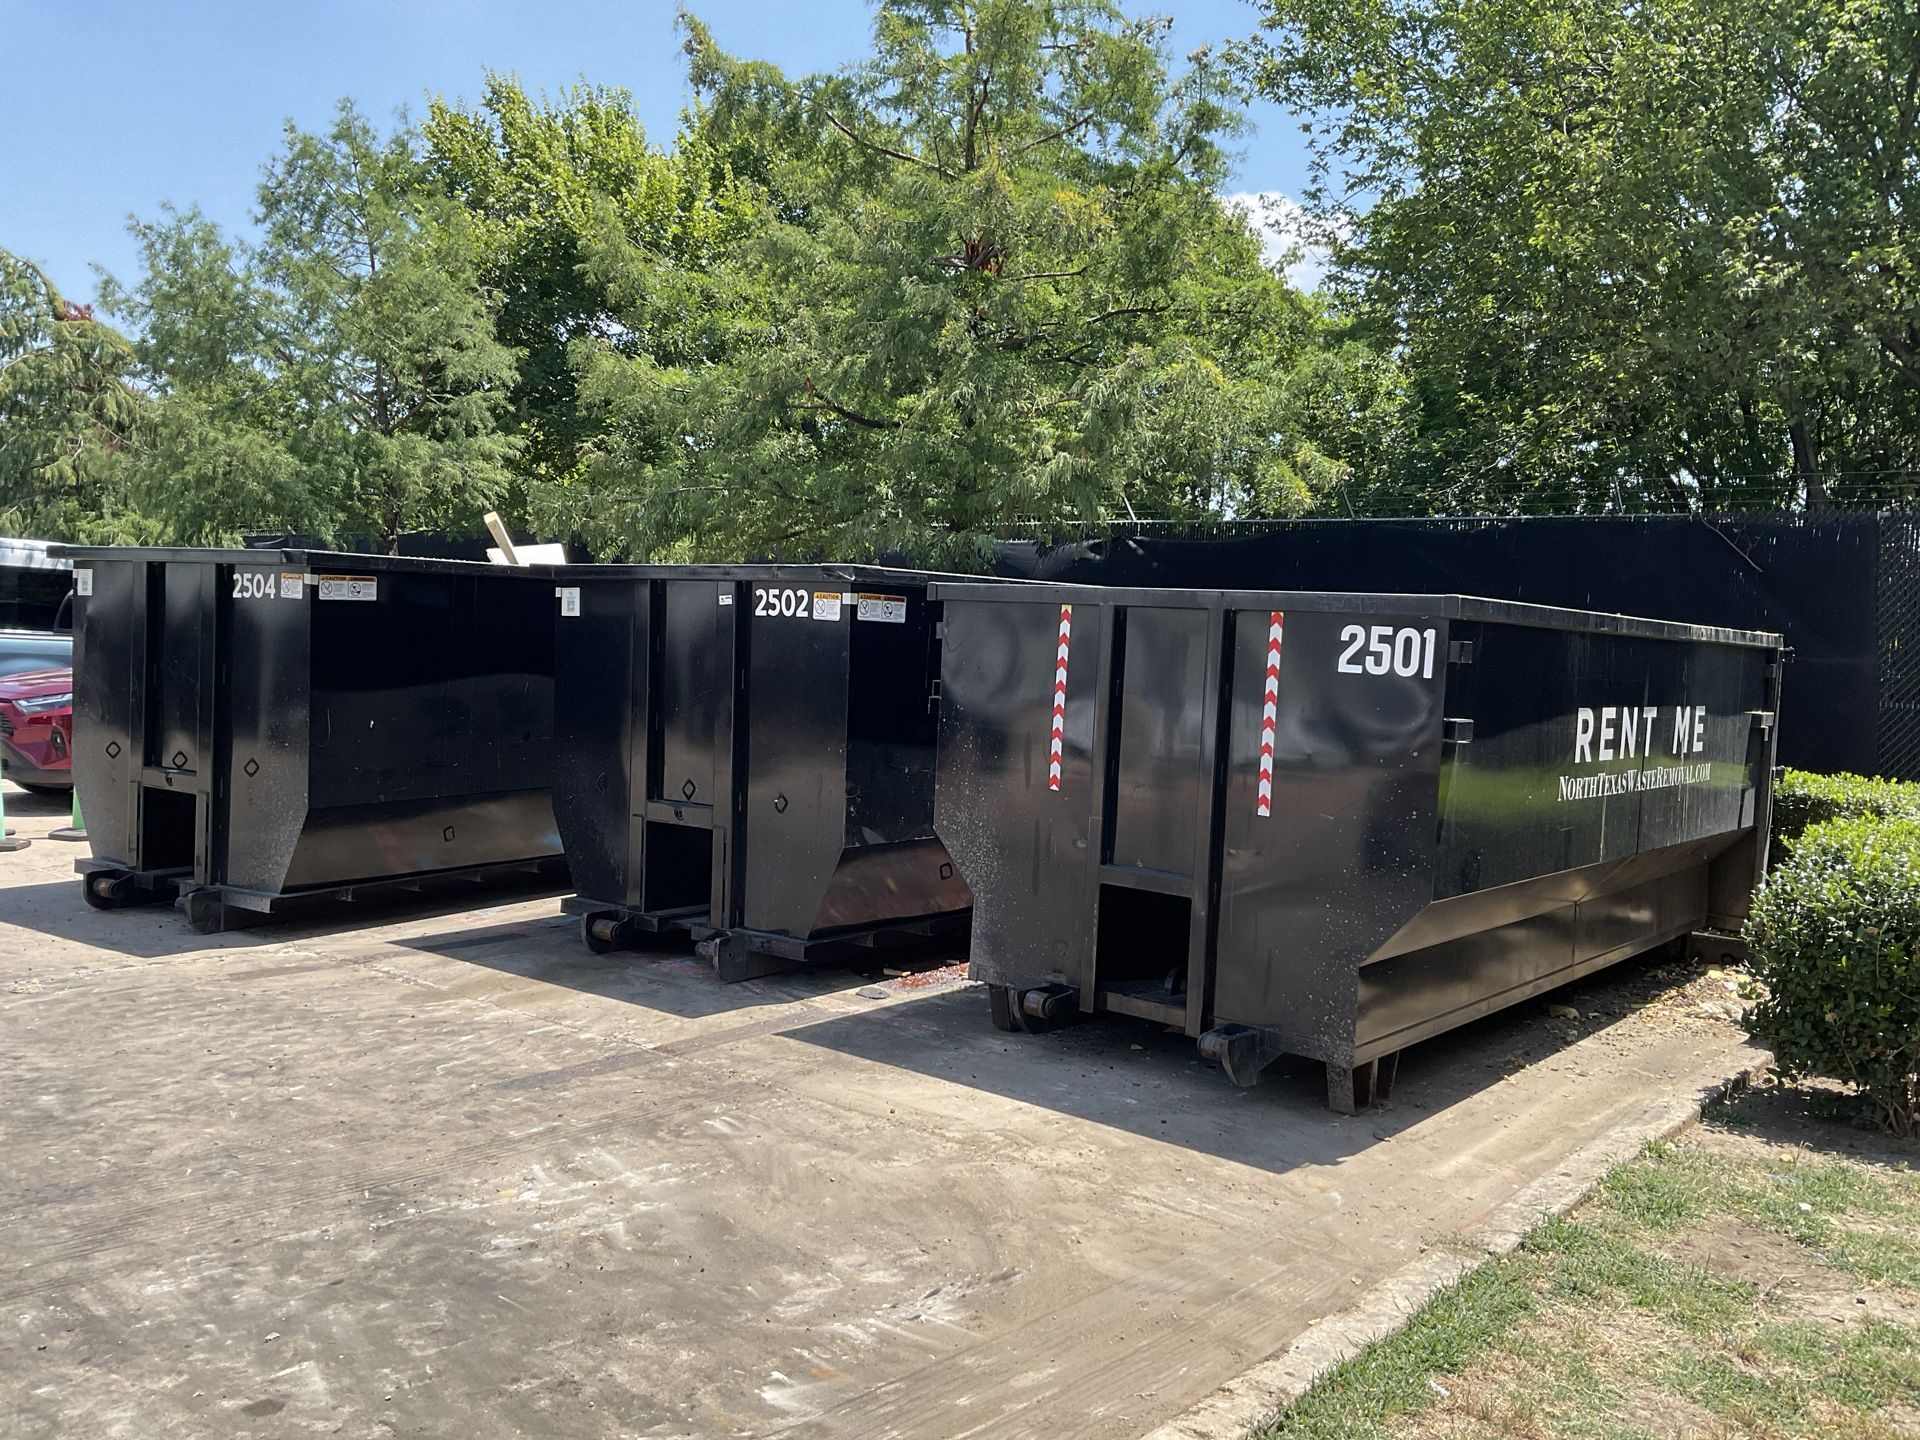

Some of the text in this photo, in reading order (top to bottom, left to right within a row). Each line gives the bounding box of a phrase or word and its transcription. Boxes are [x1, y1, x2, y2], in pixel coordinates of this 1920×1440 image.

[232, 573, 276, 600] 2504
[754, 588, 809, 618] 2502
[1337, 624, 1436, 679] 2501
[1574, 705, 1706, 764] RENT ME
